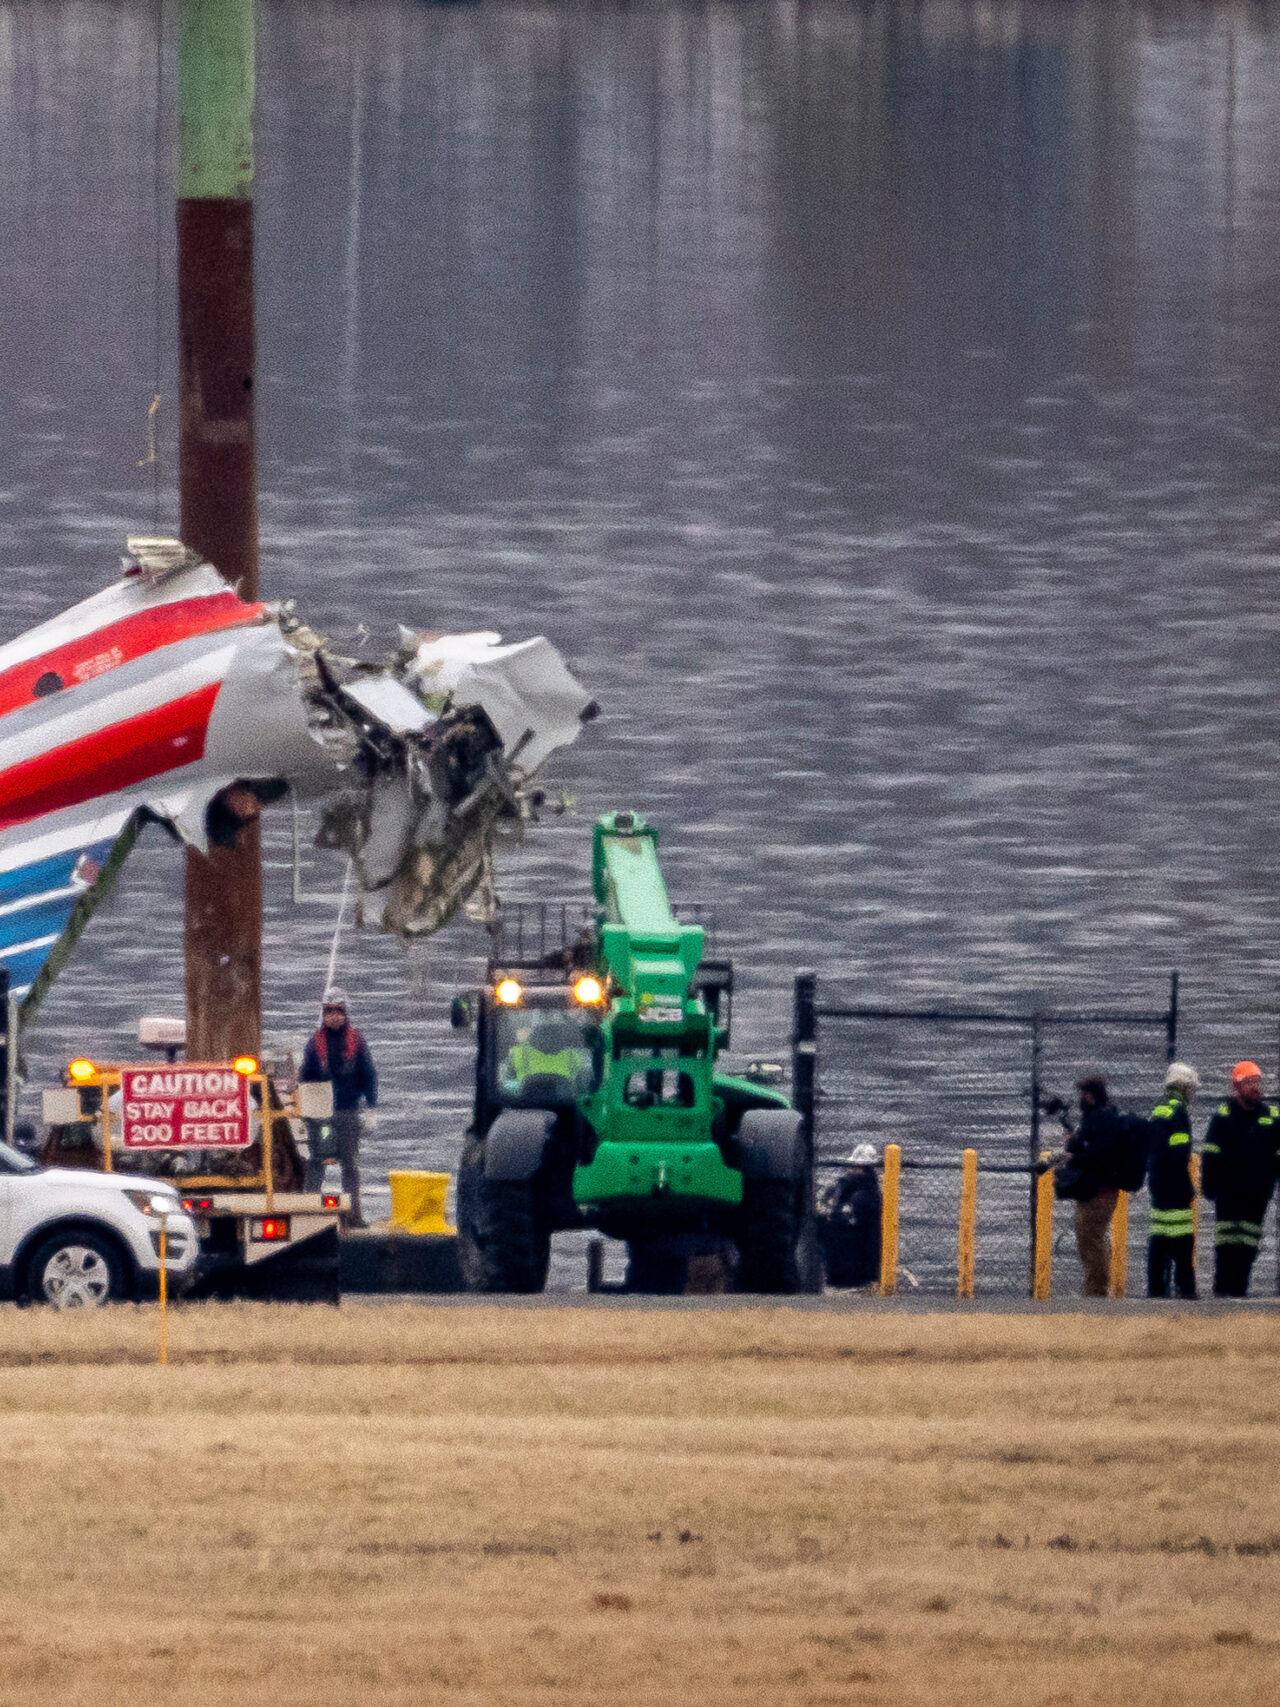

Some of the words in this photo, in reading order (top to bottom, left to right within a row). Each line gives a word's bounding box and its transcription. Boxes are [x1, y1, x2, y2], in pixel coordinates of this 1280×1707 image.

[131, 1072, 240, 1095] CAUTION
[126, 1102, 175, 1120] STAY
[183, 1099, 242, 1118] BACK
[130, 1123, 173, 1142] 200
[180, 1122, 240, 1141] FEET!
